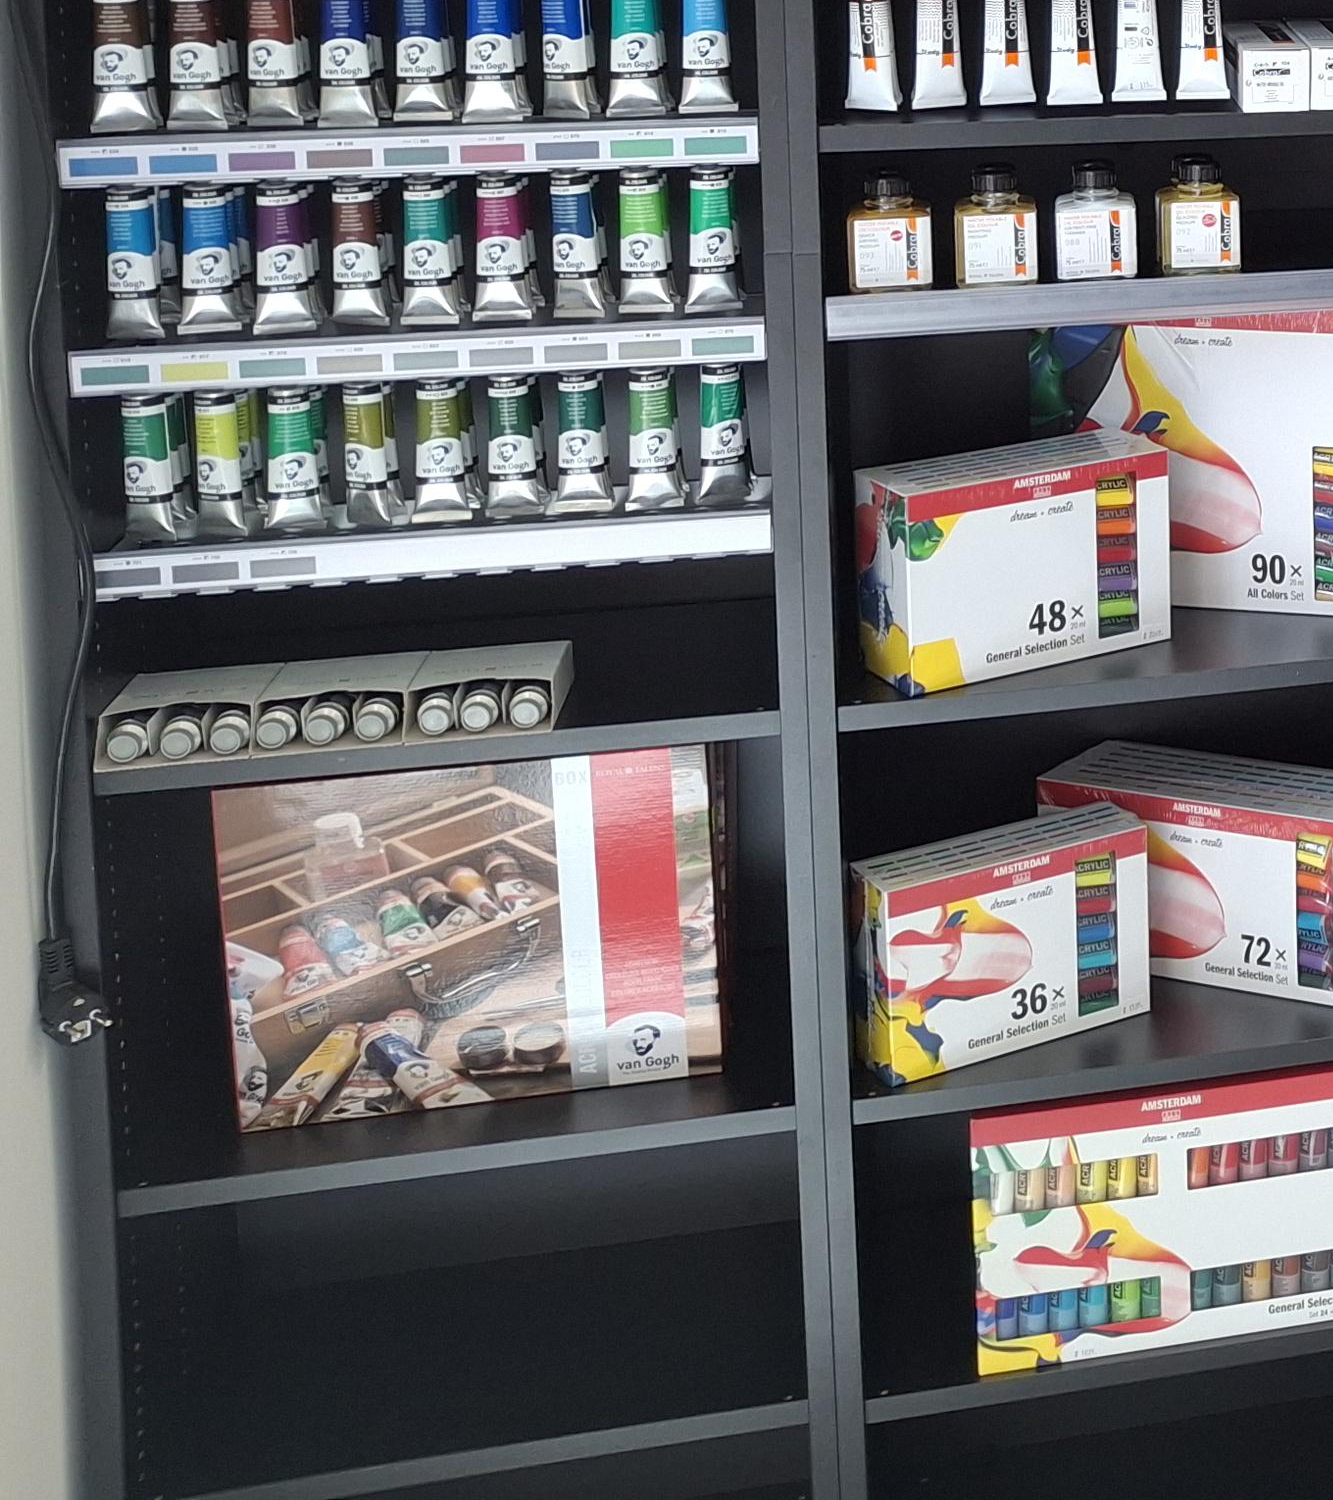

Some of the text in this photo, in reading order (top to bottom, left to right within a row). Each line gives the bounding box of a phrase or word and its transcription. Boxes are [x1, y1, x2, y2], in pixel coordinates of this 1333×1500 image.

[862, 1, 875, 45] Cobra
[906, 233, 918, 268] Cobra
[190, 274, 232, 287] van Gogh
[1013, 470, 1071, 490] AMSTERDAM
[1247, 588, 1304, 601] All Colors Set
[986, 634, 1085, 664] General Selection Set
[1173, 802, 1221, 818] AMSTERDAM
[993, 855, 1050, 877] AMSTERDAM
[1205, 962, 1288, 986] General Selection Set
[968, 1014, 1066, 1049] General Selection Set
[617, 1054, 680, 1071] van Gogh
[1141, 1094, 1202, 1112] AMSTERDAM
[1268, 1301, 1299, 1316] General
